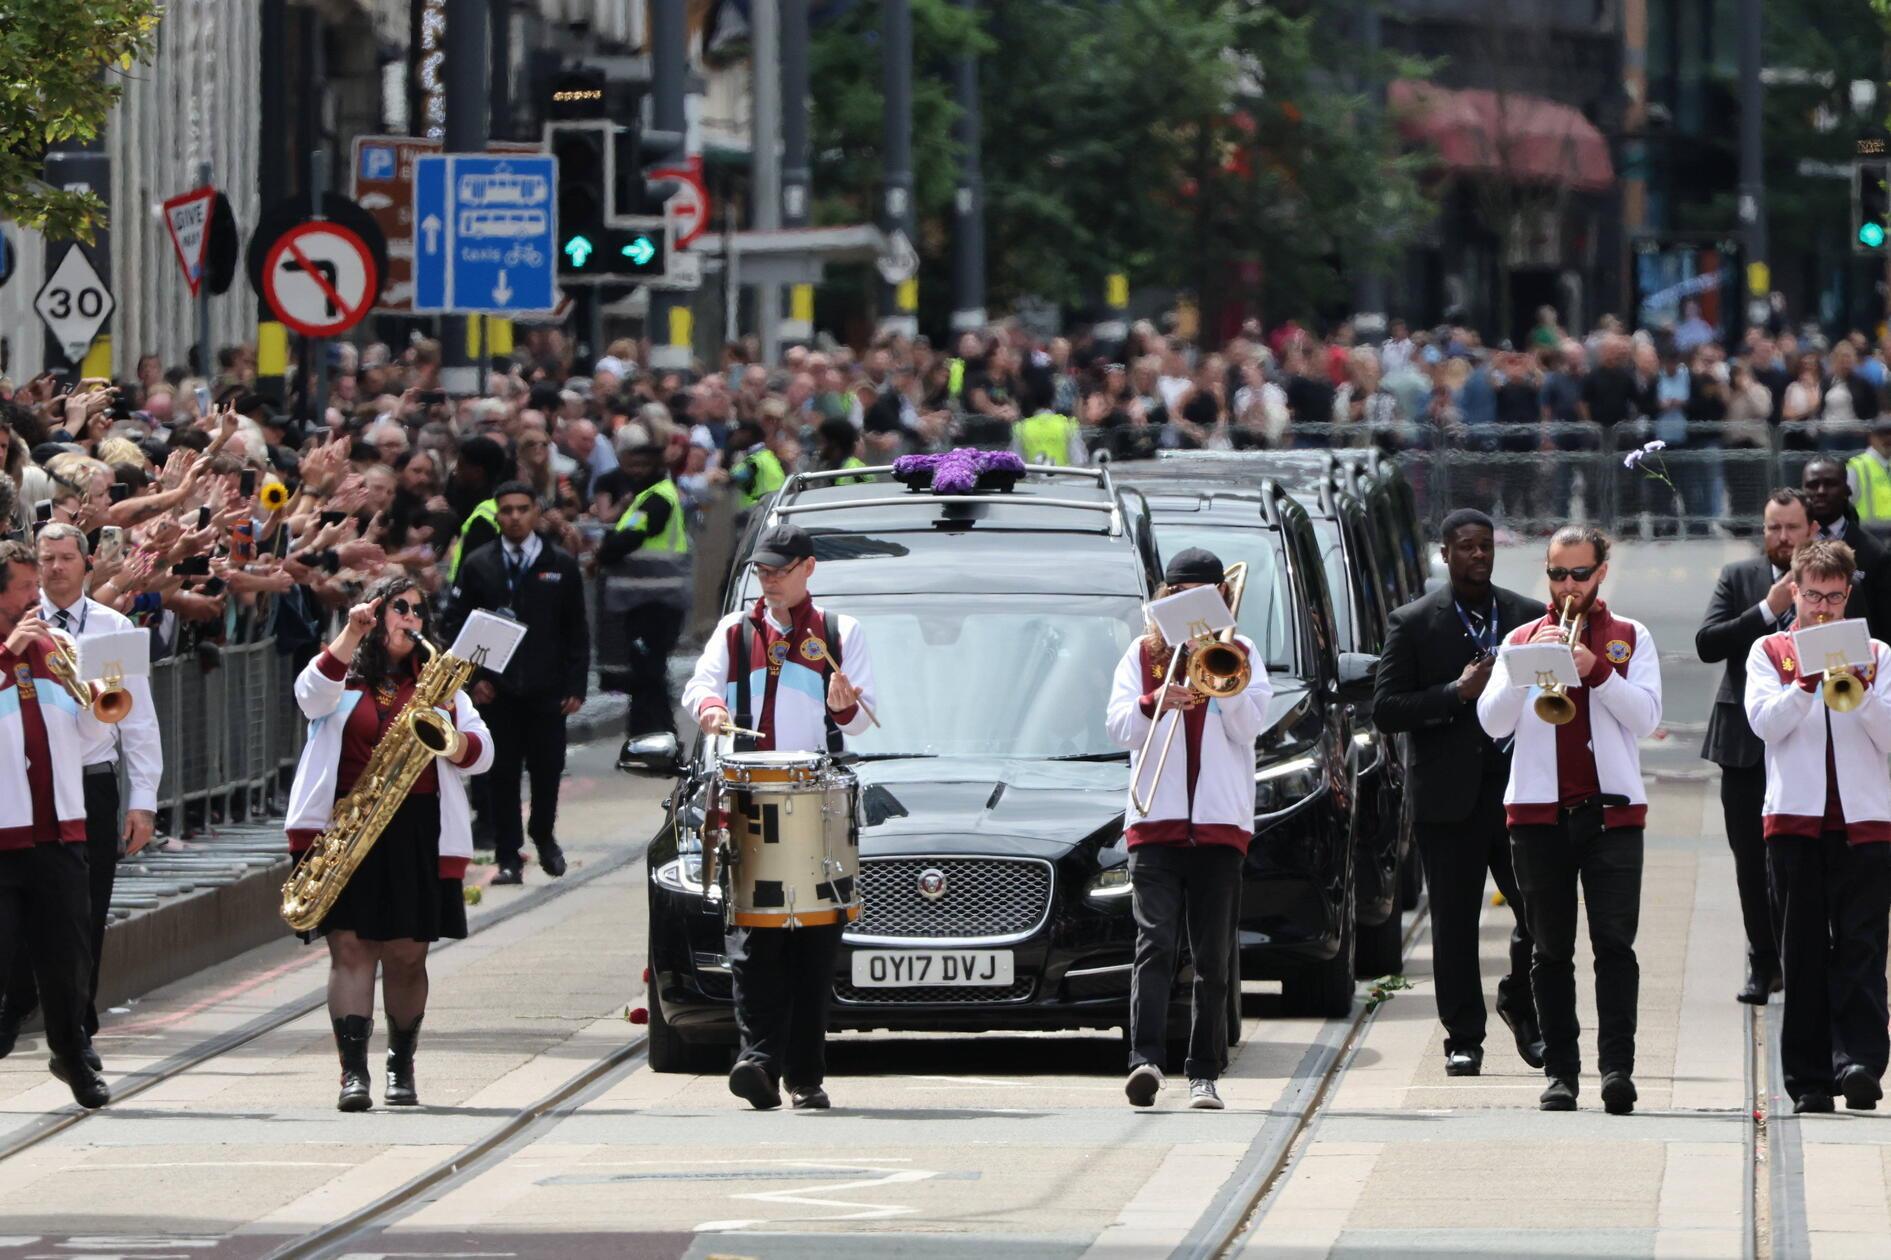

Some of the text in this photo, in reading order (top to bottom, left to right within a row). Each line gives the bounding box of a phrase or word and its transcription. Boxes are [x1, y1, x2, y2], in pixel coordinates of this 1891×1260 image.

[367, 149, 393, 178] P
[174, 203, 203, 231] GIVE
[461, 247, 501, 262] taxis
[49, 287, 103, 320] 30
[870, 955, 995, 982] OY17 DVJ
